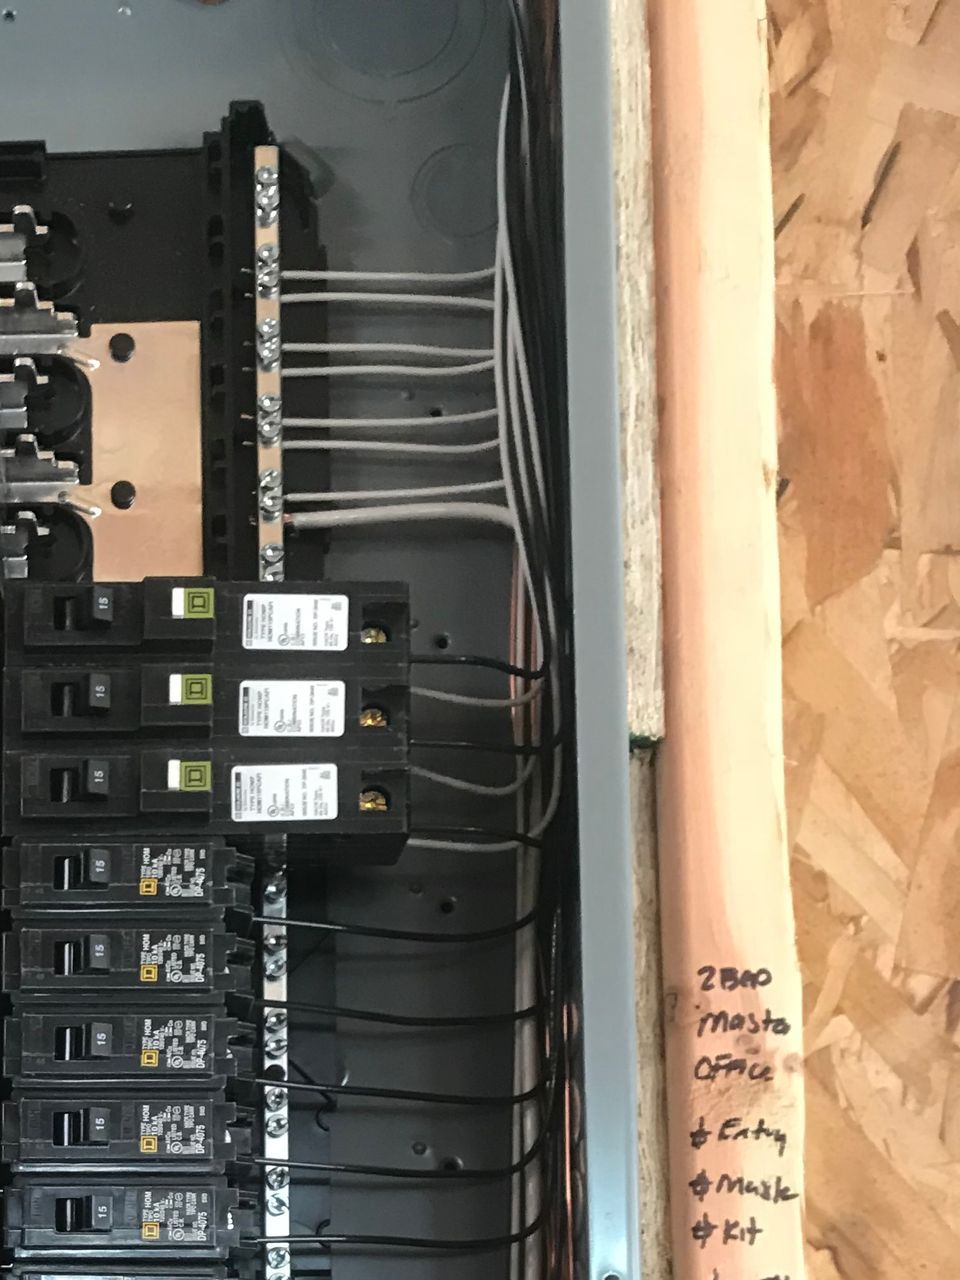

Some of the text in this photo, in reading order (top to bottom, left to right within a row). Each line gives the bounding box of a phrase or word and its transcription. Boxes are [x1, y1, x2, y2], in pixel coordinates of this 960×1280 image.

[99, 598, 108, 608] 15
[95, 686, 105, 697] 15
[94, 771, 103, 782] 15
[96, 861, 105, 872] 15
[95, 945, 104, 956] 15
[97, 1033, 106, 1045] 15
[96, 1118, 104, 1129] 15
[98, 1206, 107, 1217] 15
